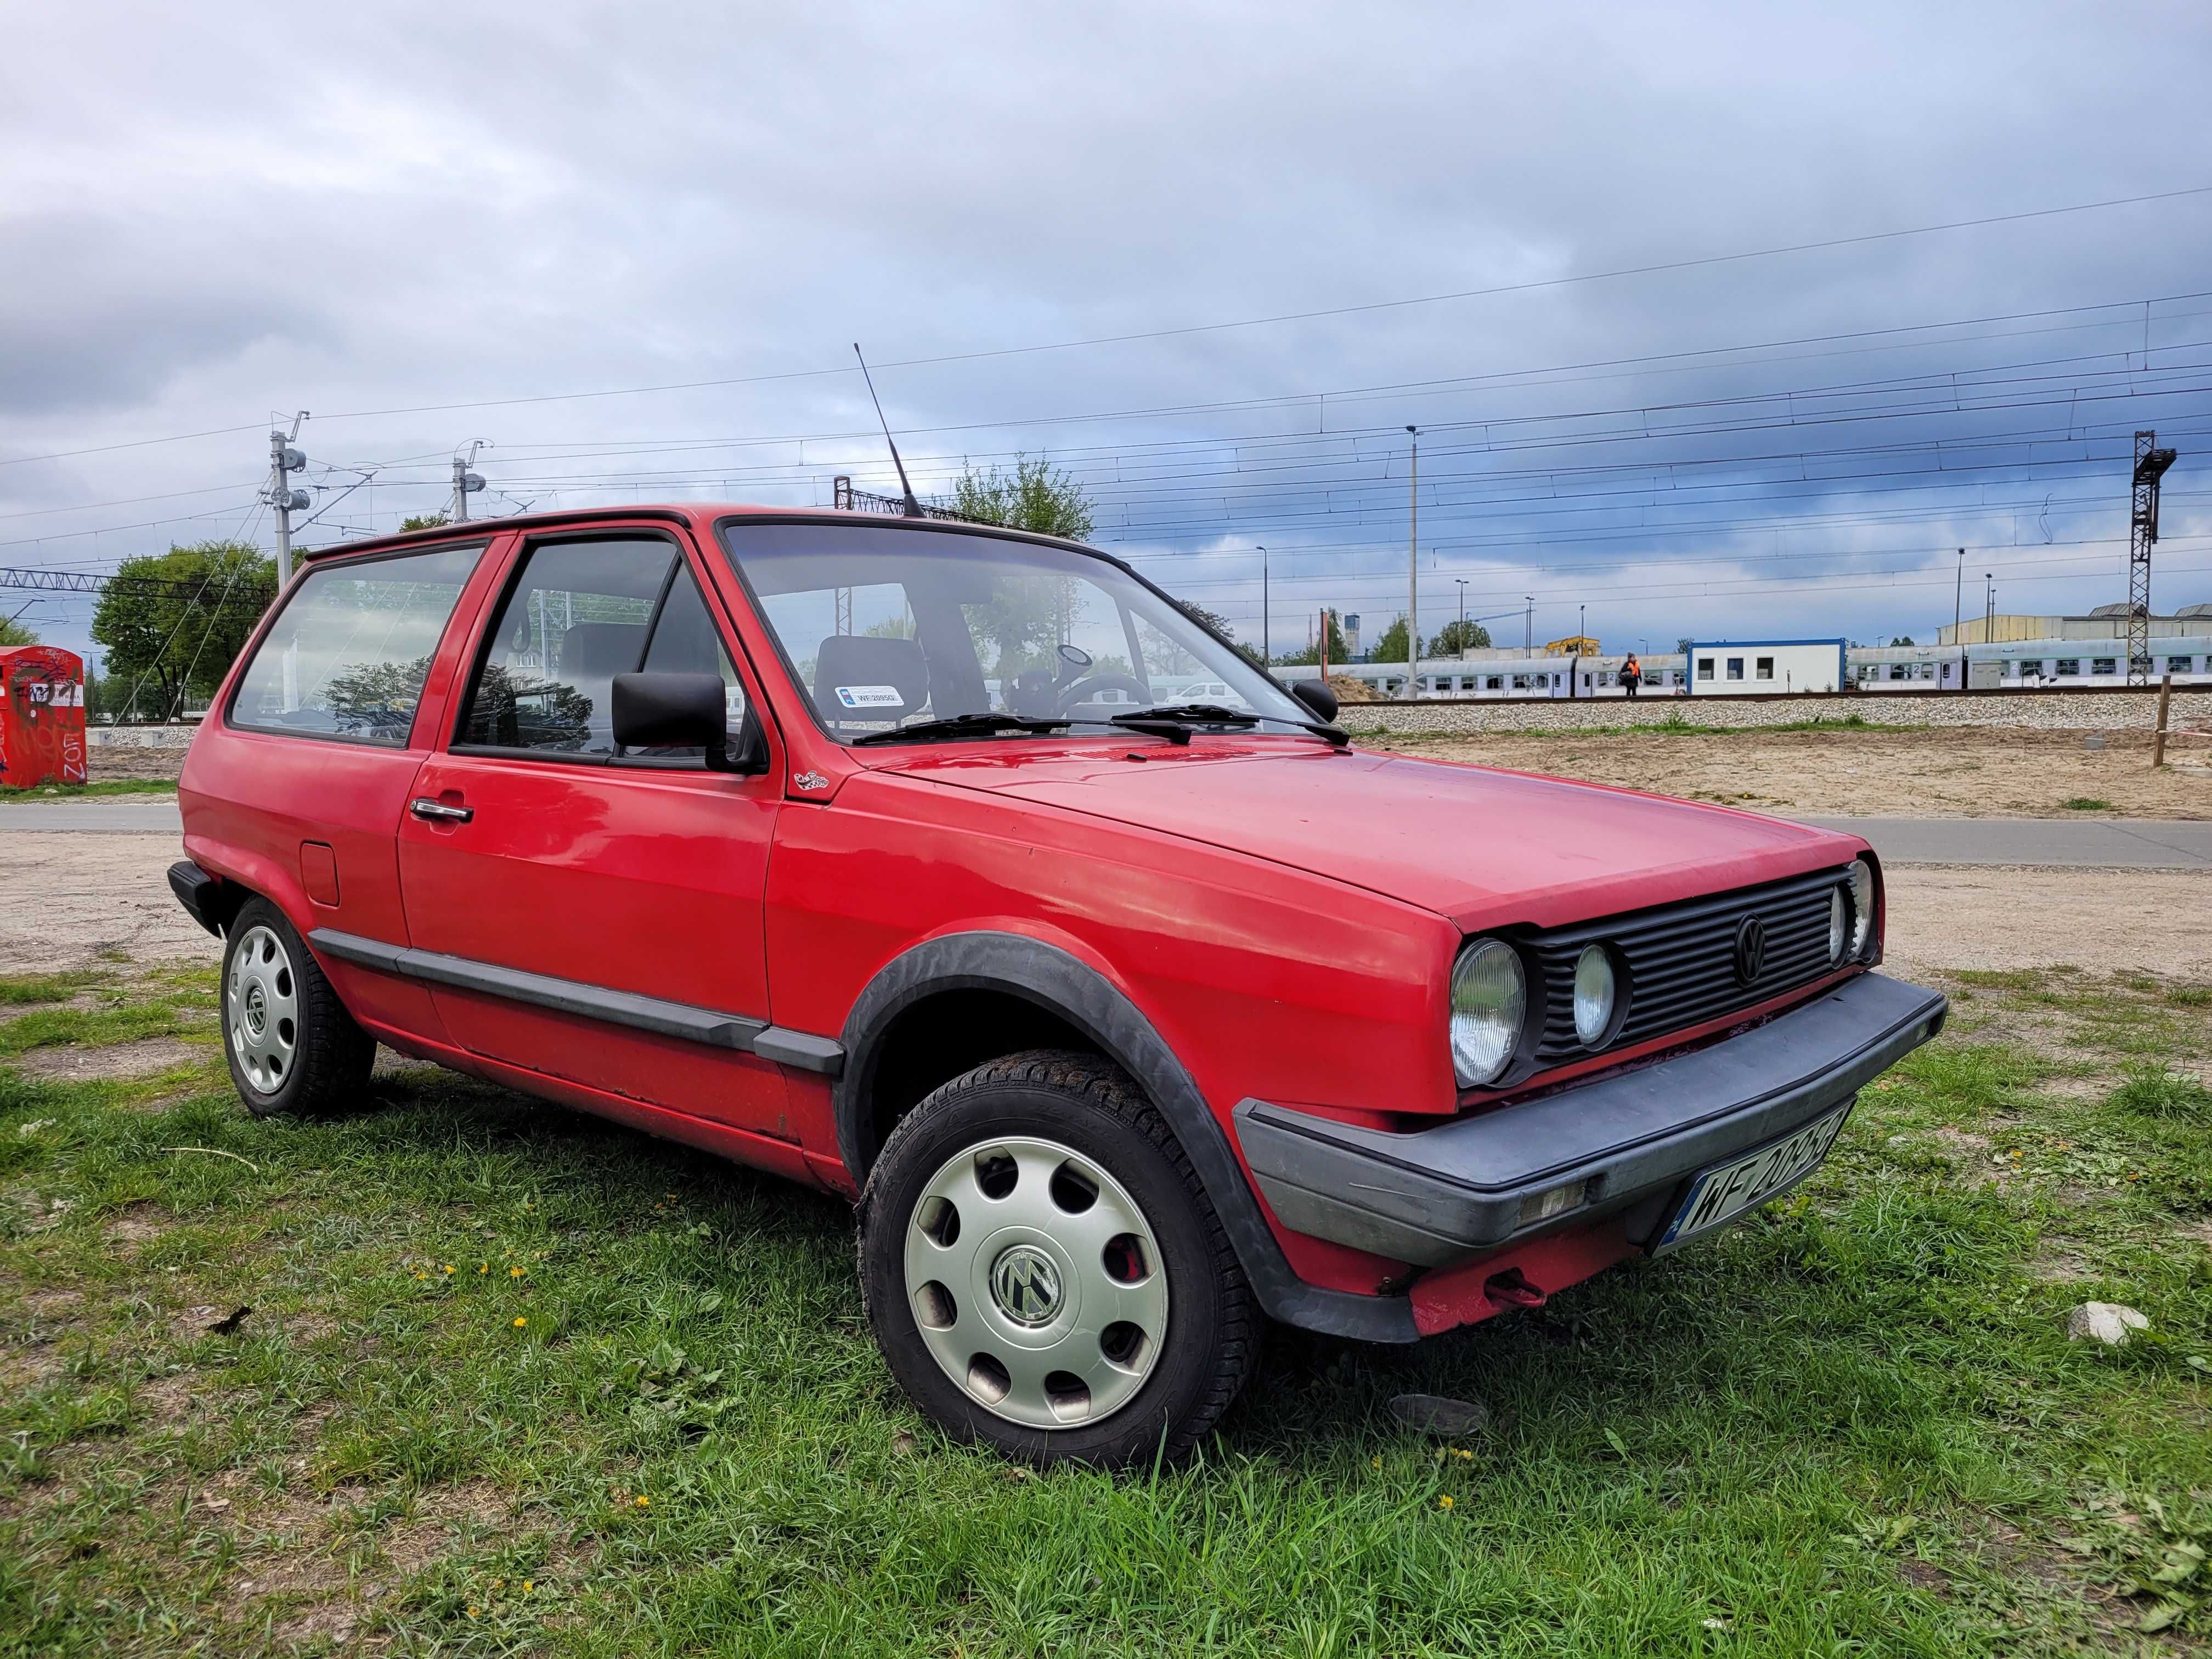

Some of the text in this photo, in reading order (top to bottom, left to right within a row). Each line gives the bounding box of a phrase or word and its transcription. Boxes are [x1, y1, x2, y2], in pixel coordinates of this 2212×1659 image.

[1671, 1108, 1844, 1232] PL WF 2095G
